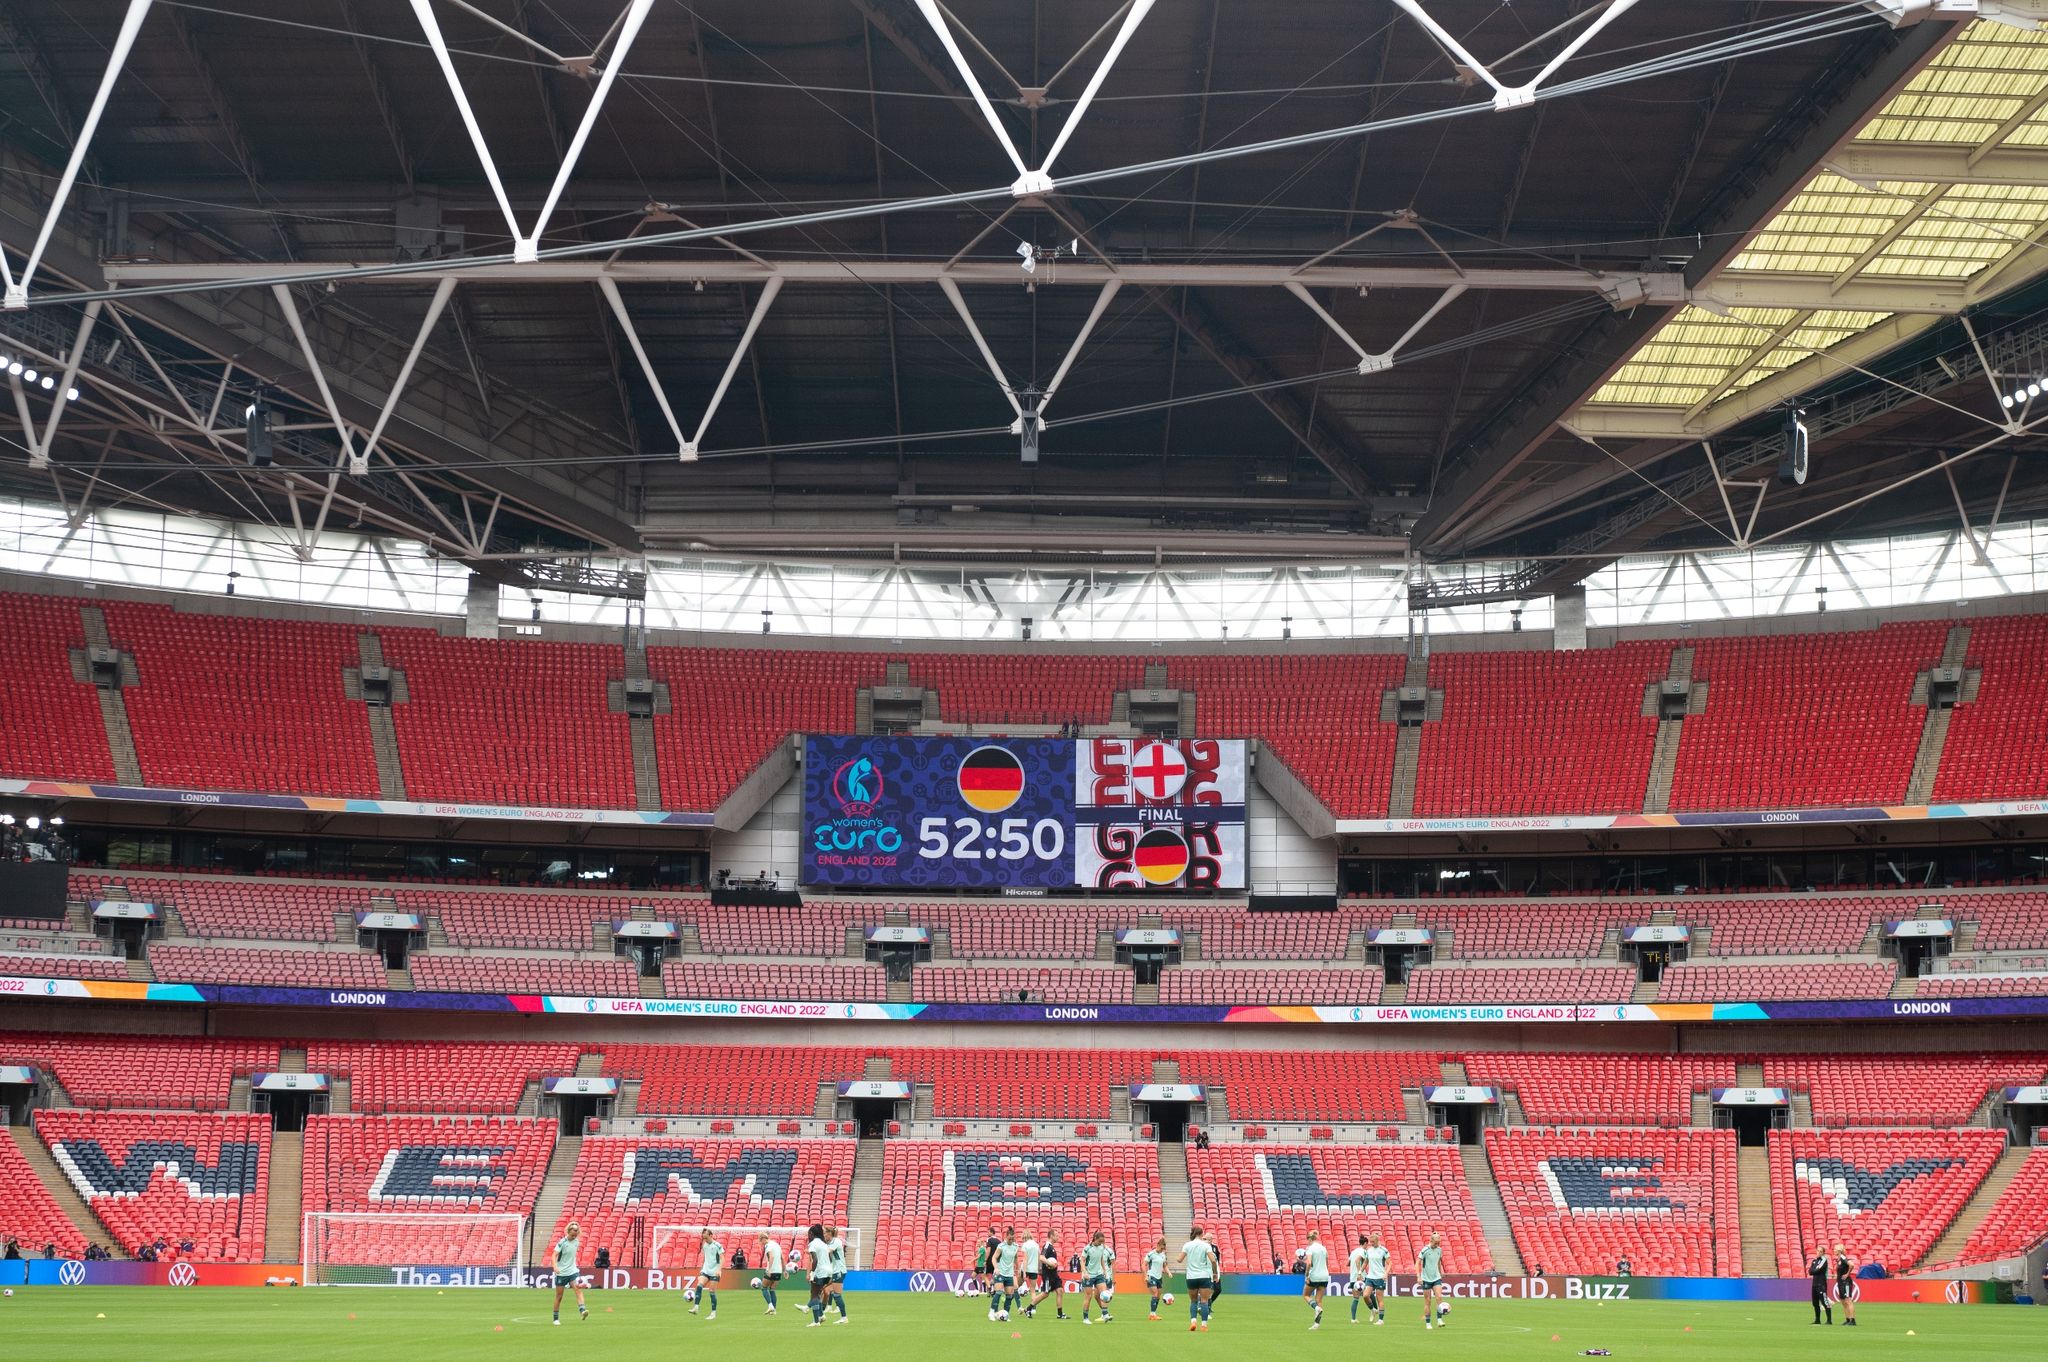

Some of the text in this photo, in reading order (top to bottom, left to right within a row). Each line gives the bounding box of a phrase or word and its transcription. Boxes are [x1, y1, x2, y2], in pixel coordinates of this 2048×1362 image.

[181, 793, 220, 803] LONDON
[435, 806, 584, 819] UEFA WOMEN'S EURO ENGLAND 2022
[843, 803, 874, 817] UEFA
[2017, 803, 2040, 811] UEFA
[1138, 809, 1183, 821] FINAL
[1761, 813, 1800, 822] LONDON
[1426, 821, 1464, 829] WOMEN'S
[1466, 820, 1489, 828] EURO
[1491, 819, 1530, 828] ENGLAND
[1531, 819, 1550, 827] 2022
[918, 817, 1065, 860] 52:50
[818, 855, 897, 866] ENGLAND 2022
[1005, 888, 1044, 896] Hisense
[331, 992, 386, 1005] LONDON
[611, 1001, 827, 1015] UEFA WOMEN'S EURO ENGLAND 2022
[1045, 1008, 1099, 1019] LONDON
[1377, 1008, 1597, 1019] UEFA WOMEN'S EURO ENGLAND 2022
[1894, 1002, 1951, 1014] LONDON
[392, 1267, 440, 1286] The
[603, 1269, 637, 1289] ID.
[647, 1269, 710, 1289] Buz
[1313, 1275, 1354, 1297] he
[1521, 1278, 1557, 1299] ID.
[1565, 1277, 1630, 1300] Buzz
